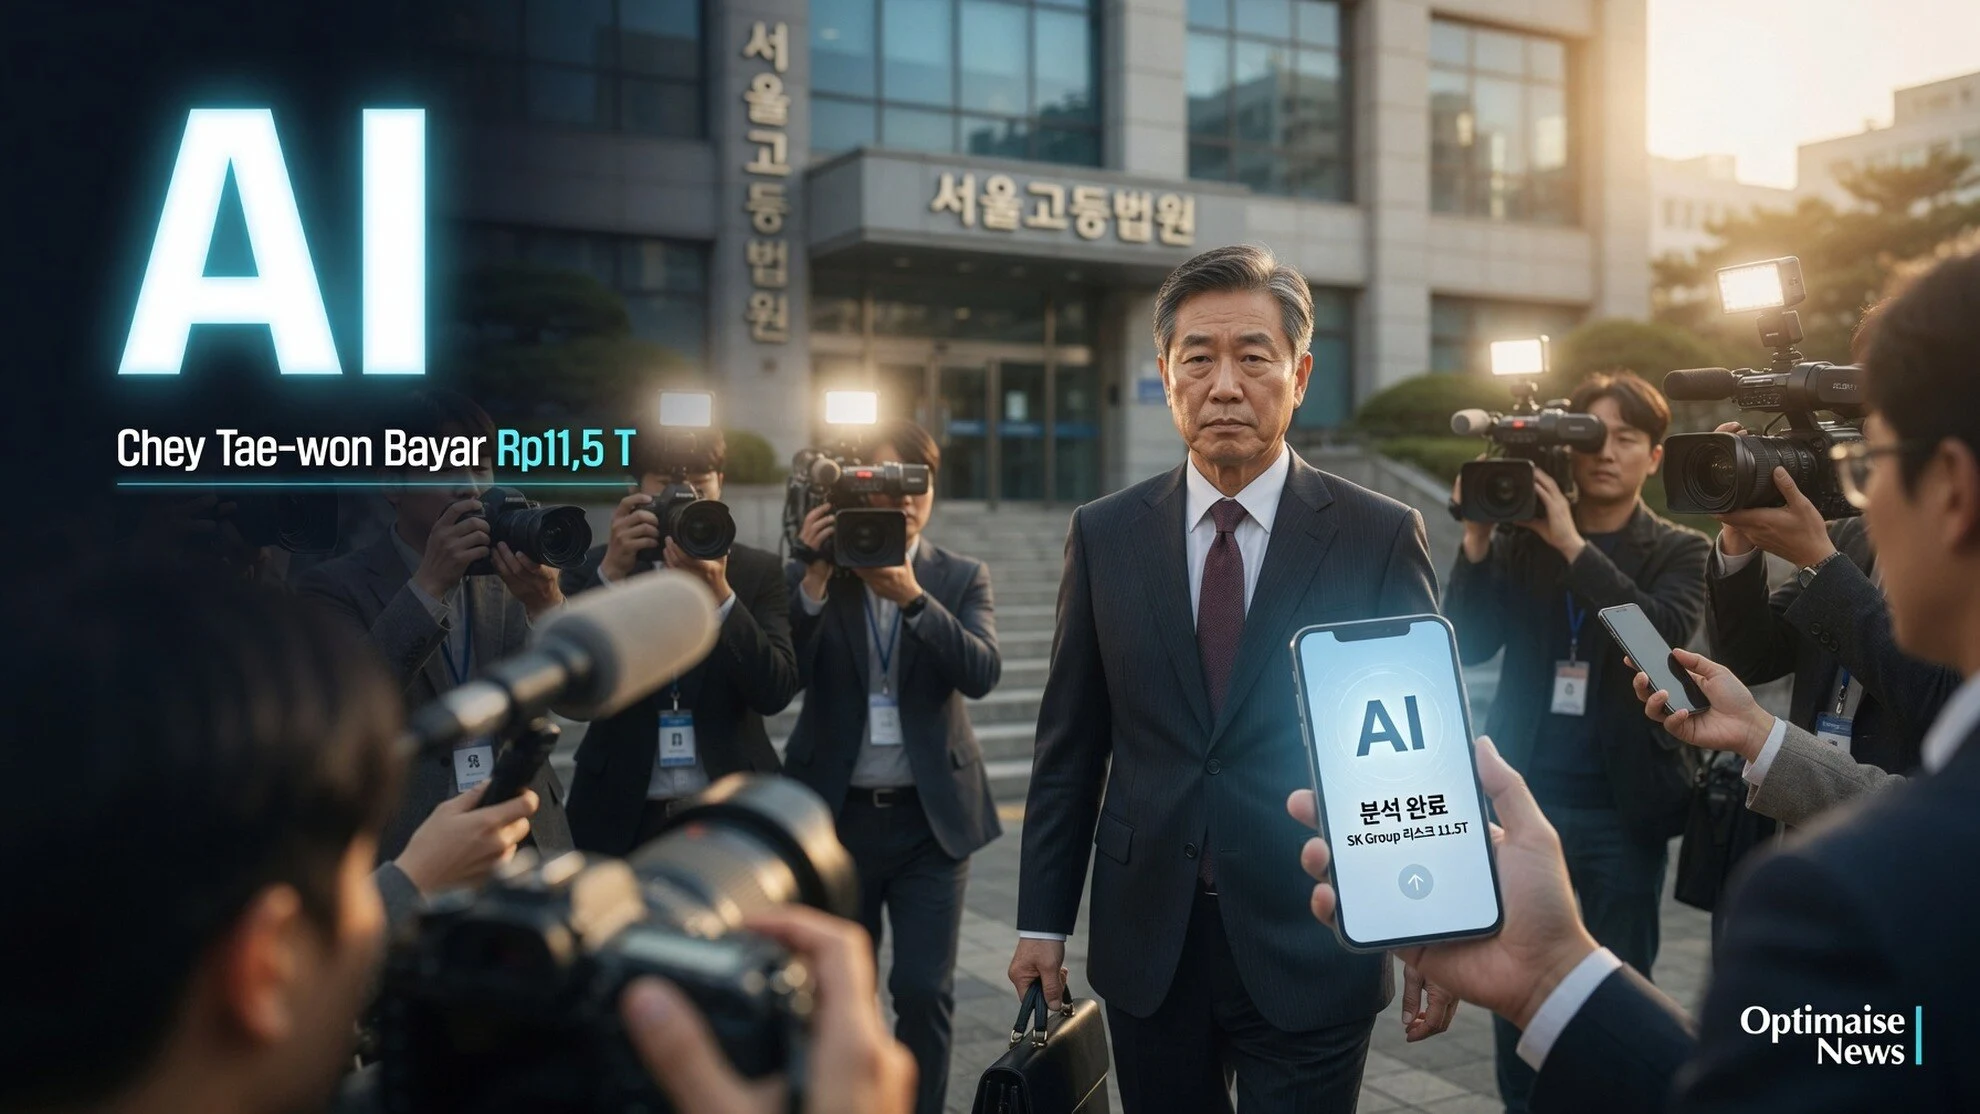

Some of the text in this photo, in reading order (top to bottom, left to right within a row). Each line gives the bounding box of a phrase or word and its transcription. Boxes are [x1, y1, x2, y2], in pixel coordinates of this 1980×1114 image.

[744, 20, 791, 345] 서울고등법원
[930, 172, 1197, 246] 서울고등법원
[1356, 694, 1426, 758] AI
[1347, 821, 1469, 847] SK Group 리스크 11.5T
[1360, 794, 1449, 826] 분석 완료
